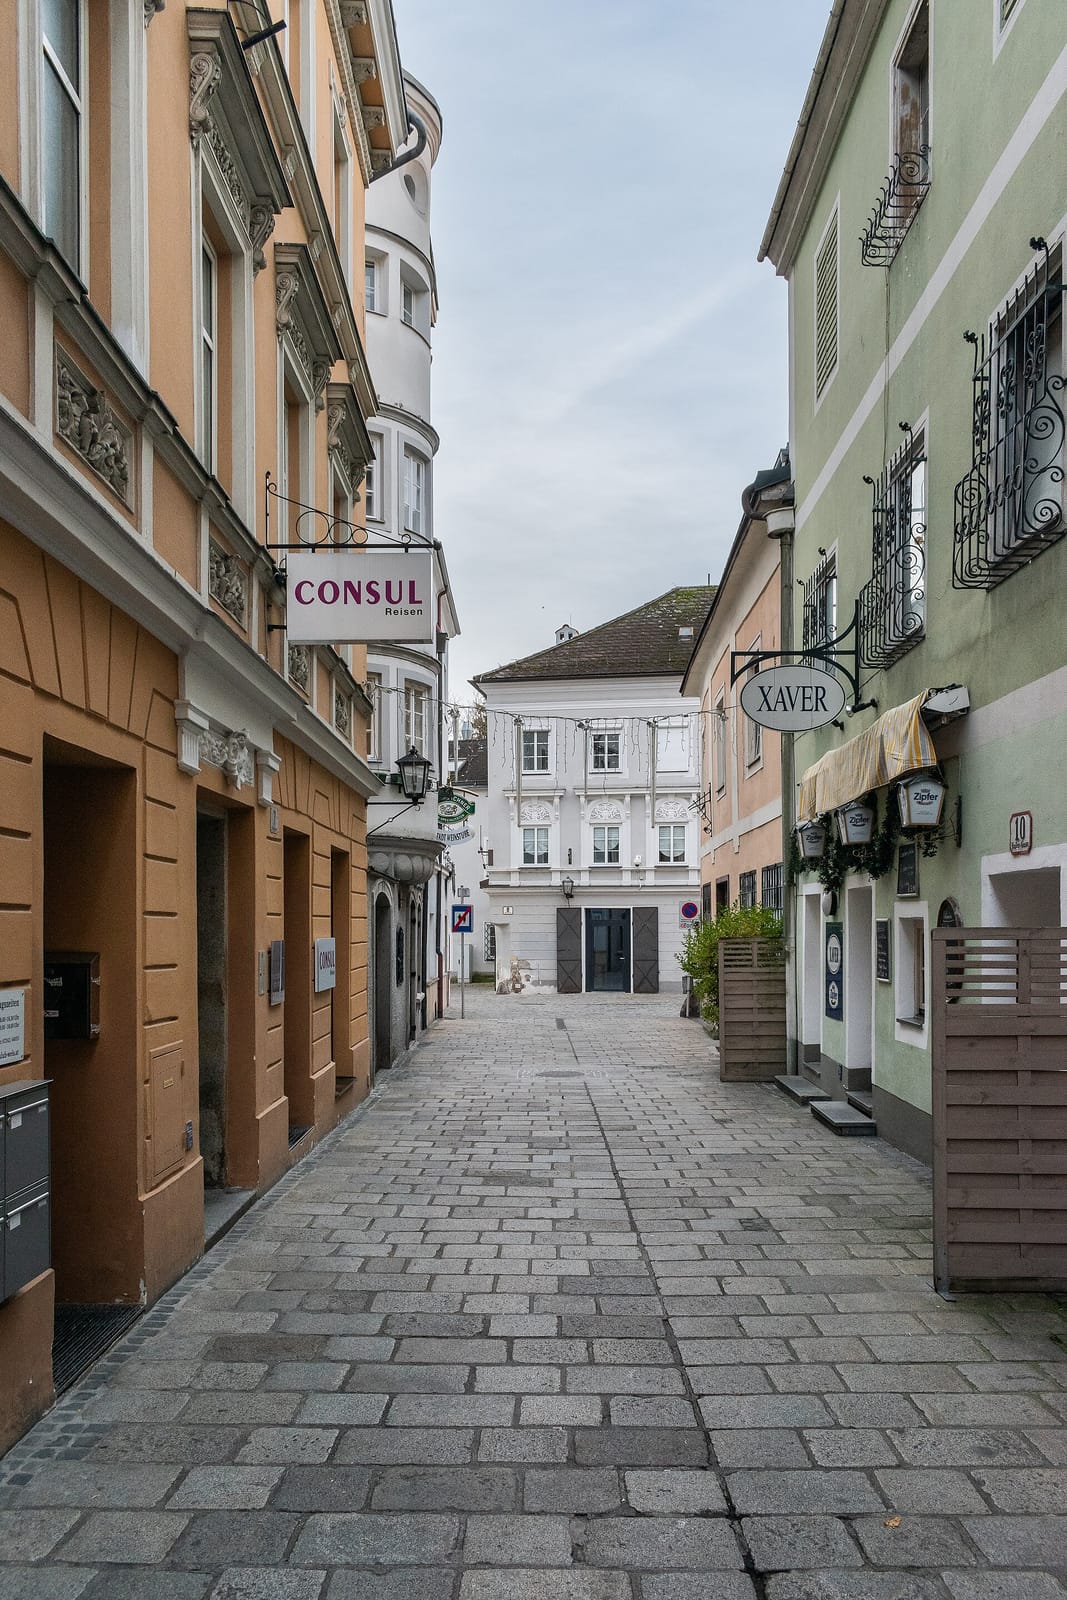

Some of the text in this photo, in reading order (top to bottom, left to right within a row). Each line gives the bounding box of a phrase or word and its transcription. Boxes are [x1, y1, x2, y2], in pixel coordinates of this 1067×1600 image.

[294, 580, 423, 605] CONSUL
[385, 607, 423, 616] Reisen
[756, 685, 829, 712] XAVER
[913, 792, 939, 802] Zipfer
[849, 816, 870, 824] Zipfer
[1014, 816, 1026, 841] 10
